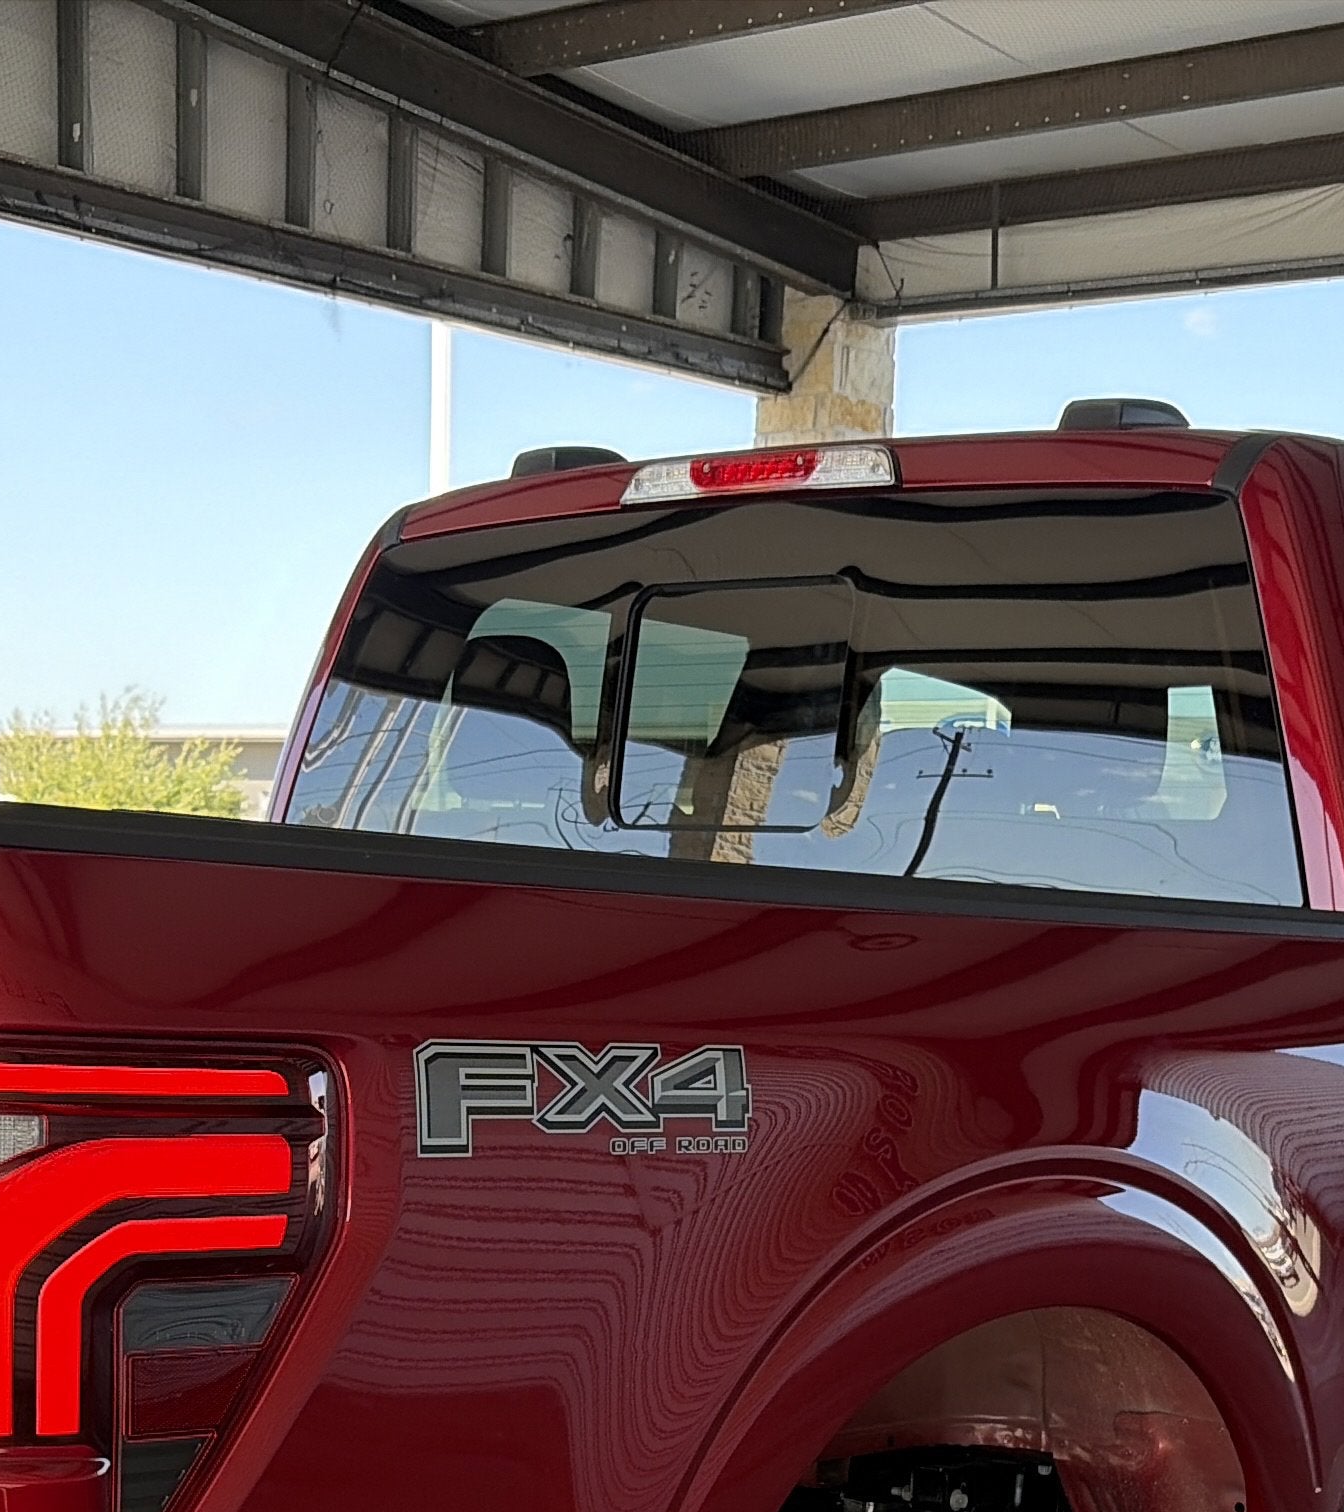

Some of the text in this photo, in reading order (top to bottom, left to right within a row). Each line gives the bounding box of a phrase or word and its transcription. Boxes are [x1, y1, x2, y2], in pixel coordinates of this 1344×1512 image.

[413, 1039, 752, 1157] FX4
[609, 1136, 748, 1155] OFF ROAD
